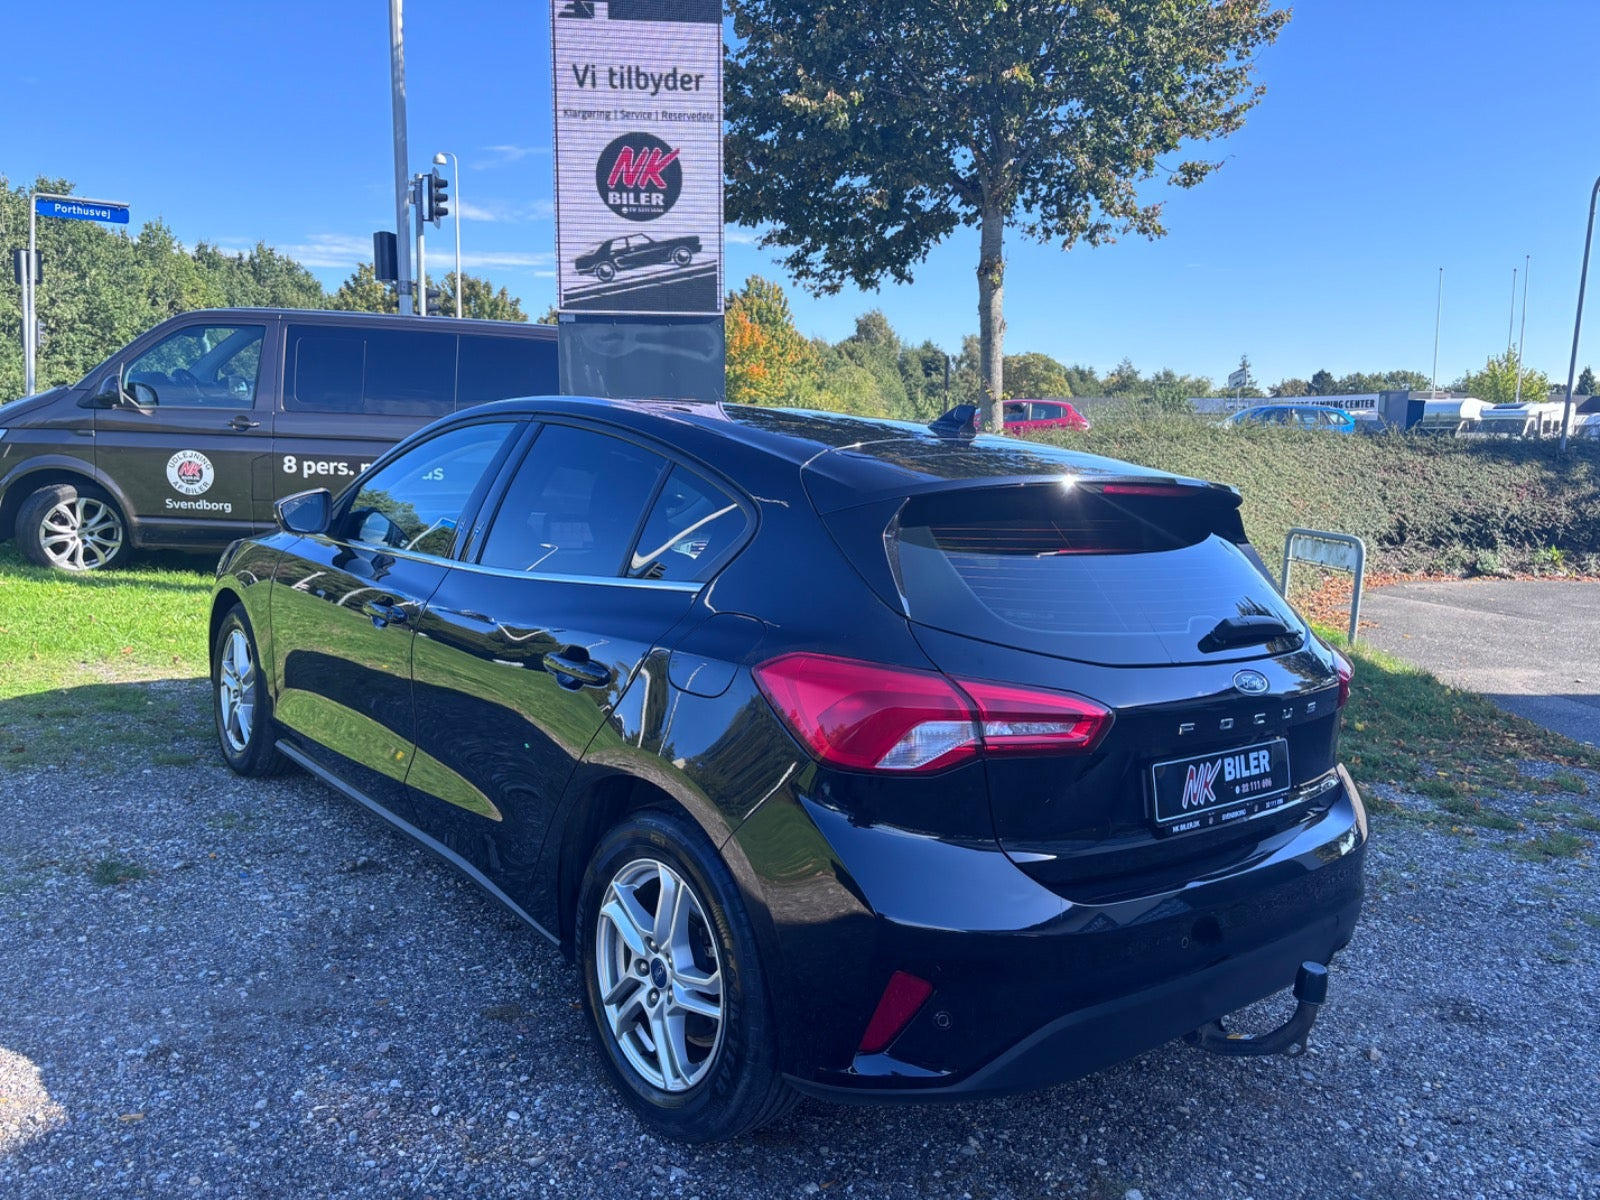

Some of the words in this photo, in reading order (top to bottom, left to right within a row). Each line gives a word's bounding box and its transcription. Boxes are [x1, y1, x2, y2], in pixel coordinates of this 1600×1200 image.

[572, 63, 596, 89] Vi
[608, 65, 704, 96] tilbyder
[620, 110, 651, 121] Service
[607, 145, 680, 190] NK
[608, 191, 665, 206] BILER
[54, 203, 111, 219] Porthusvej
[1345, 399, 1376, 409] CENTER
[168, 451, 212, 471] UDLEJNING
[178, 460, 203, 477] NK
[283, 455, 298, 474] 8
[302, 459, 354, 479] pers.
[172, 480, 185, 490] AF
[185, 480, 210, 495] BILER
[165, 498, 232, 513] Svendborg
[1178, 701, 1317, 736] FOCUS
[1182, 757, 1222, 809] NK
[1223, 750, 1271, 782] BILER
